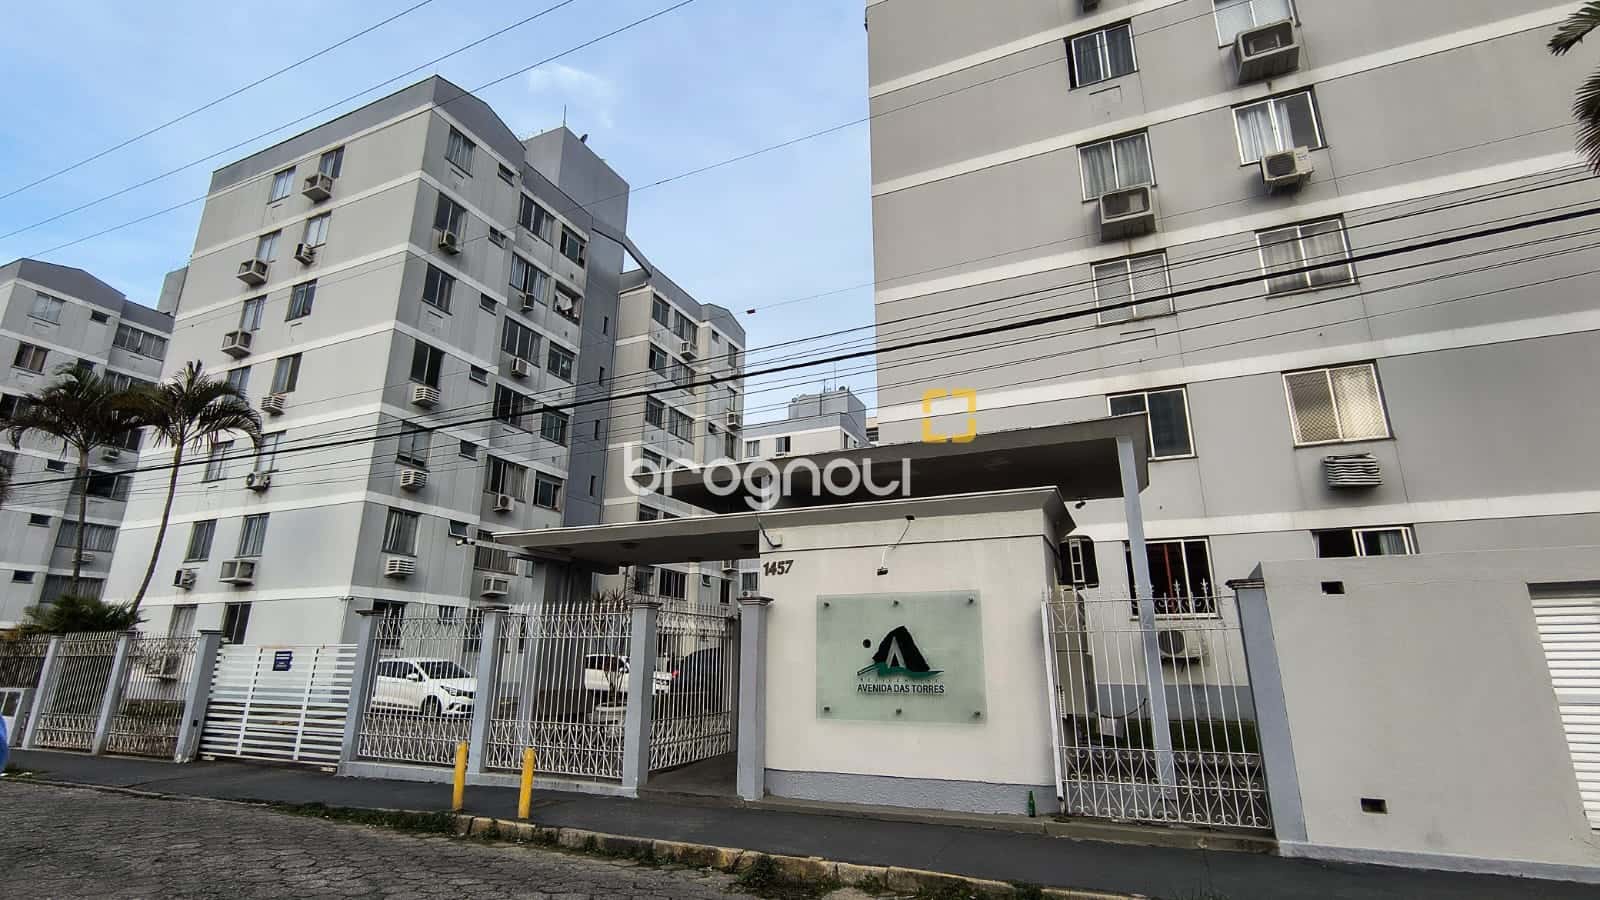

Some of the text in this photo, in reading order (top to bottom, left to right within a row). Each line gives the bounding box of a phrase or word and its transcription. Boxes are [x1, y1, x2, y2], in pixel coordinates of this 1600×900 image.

[763, 560, 794, 576] 1457
[857, 684, 945, 694] AVENIDA DAS TORRES
